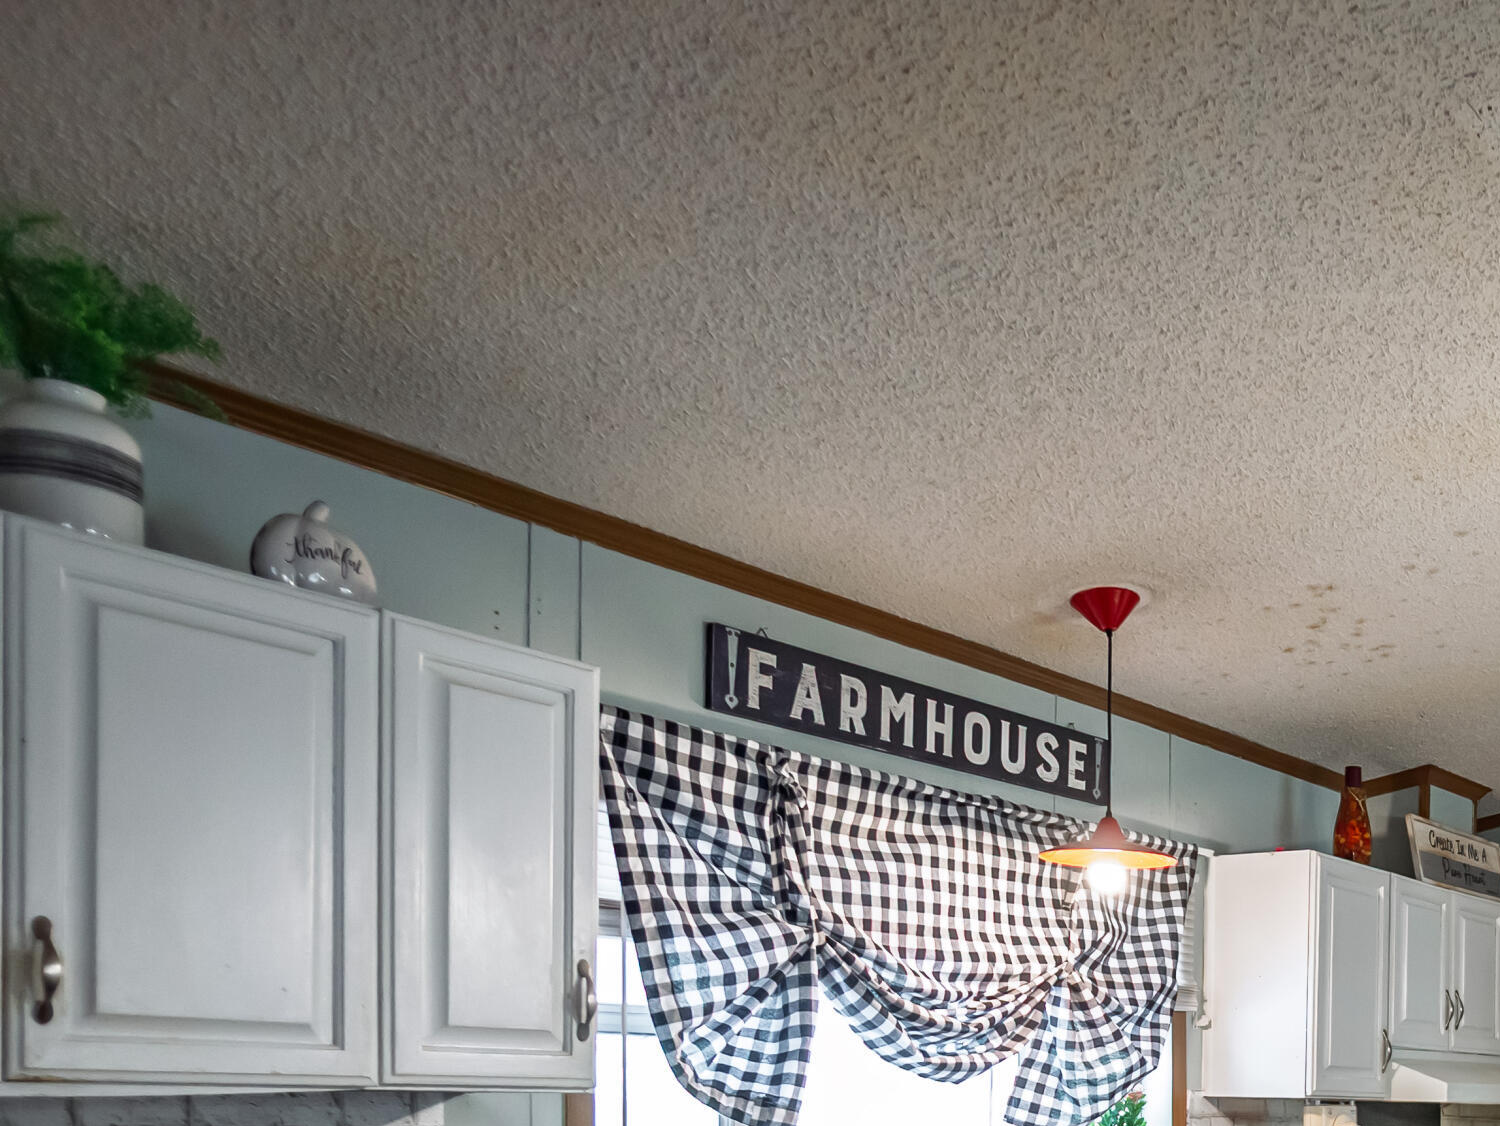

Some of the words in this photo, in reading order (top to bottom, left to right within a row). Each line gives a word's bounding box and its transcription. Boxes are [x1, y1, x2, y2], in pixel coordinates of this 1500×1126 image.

[746, 647, 1089, 791] FARMHOUSE
[1429, 829, 1454, 855] Create
[1455, 839, 1466, 857] In
[1467, 843, 1480, 862] Me
[1481, 847, 1487, 864] A
